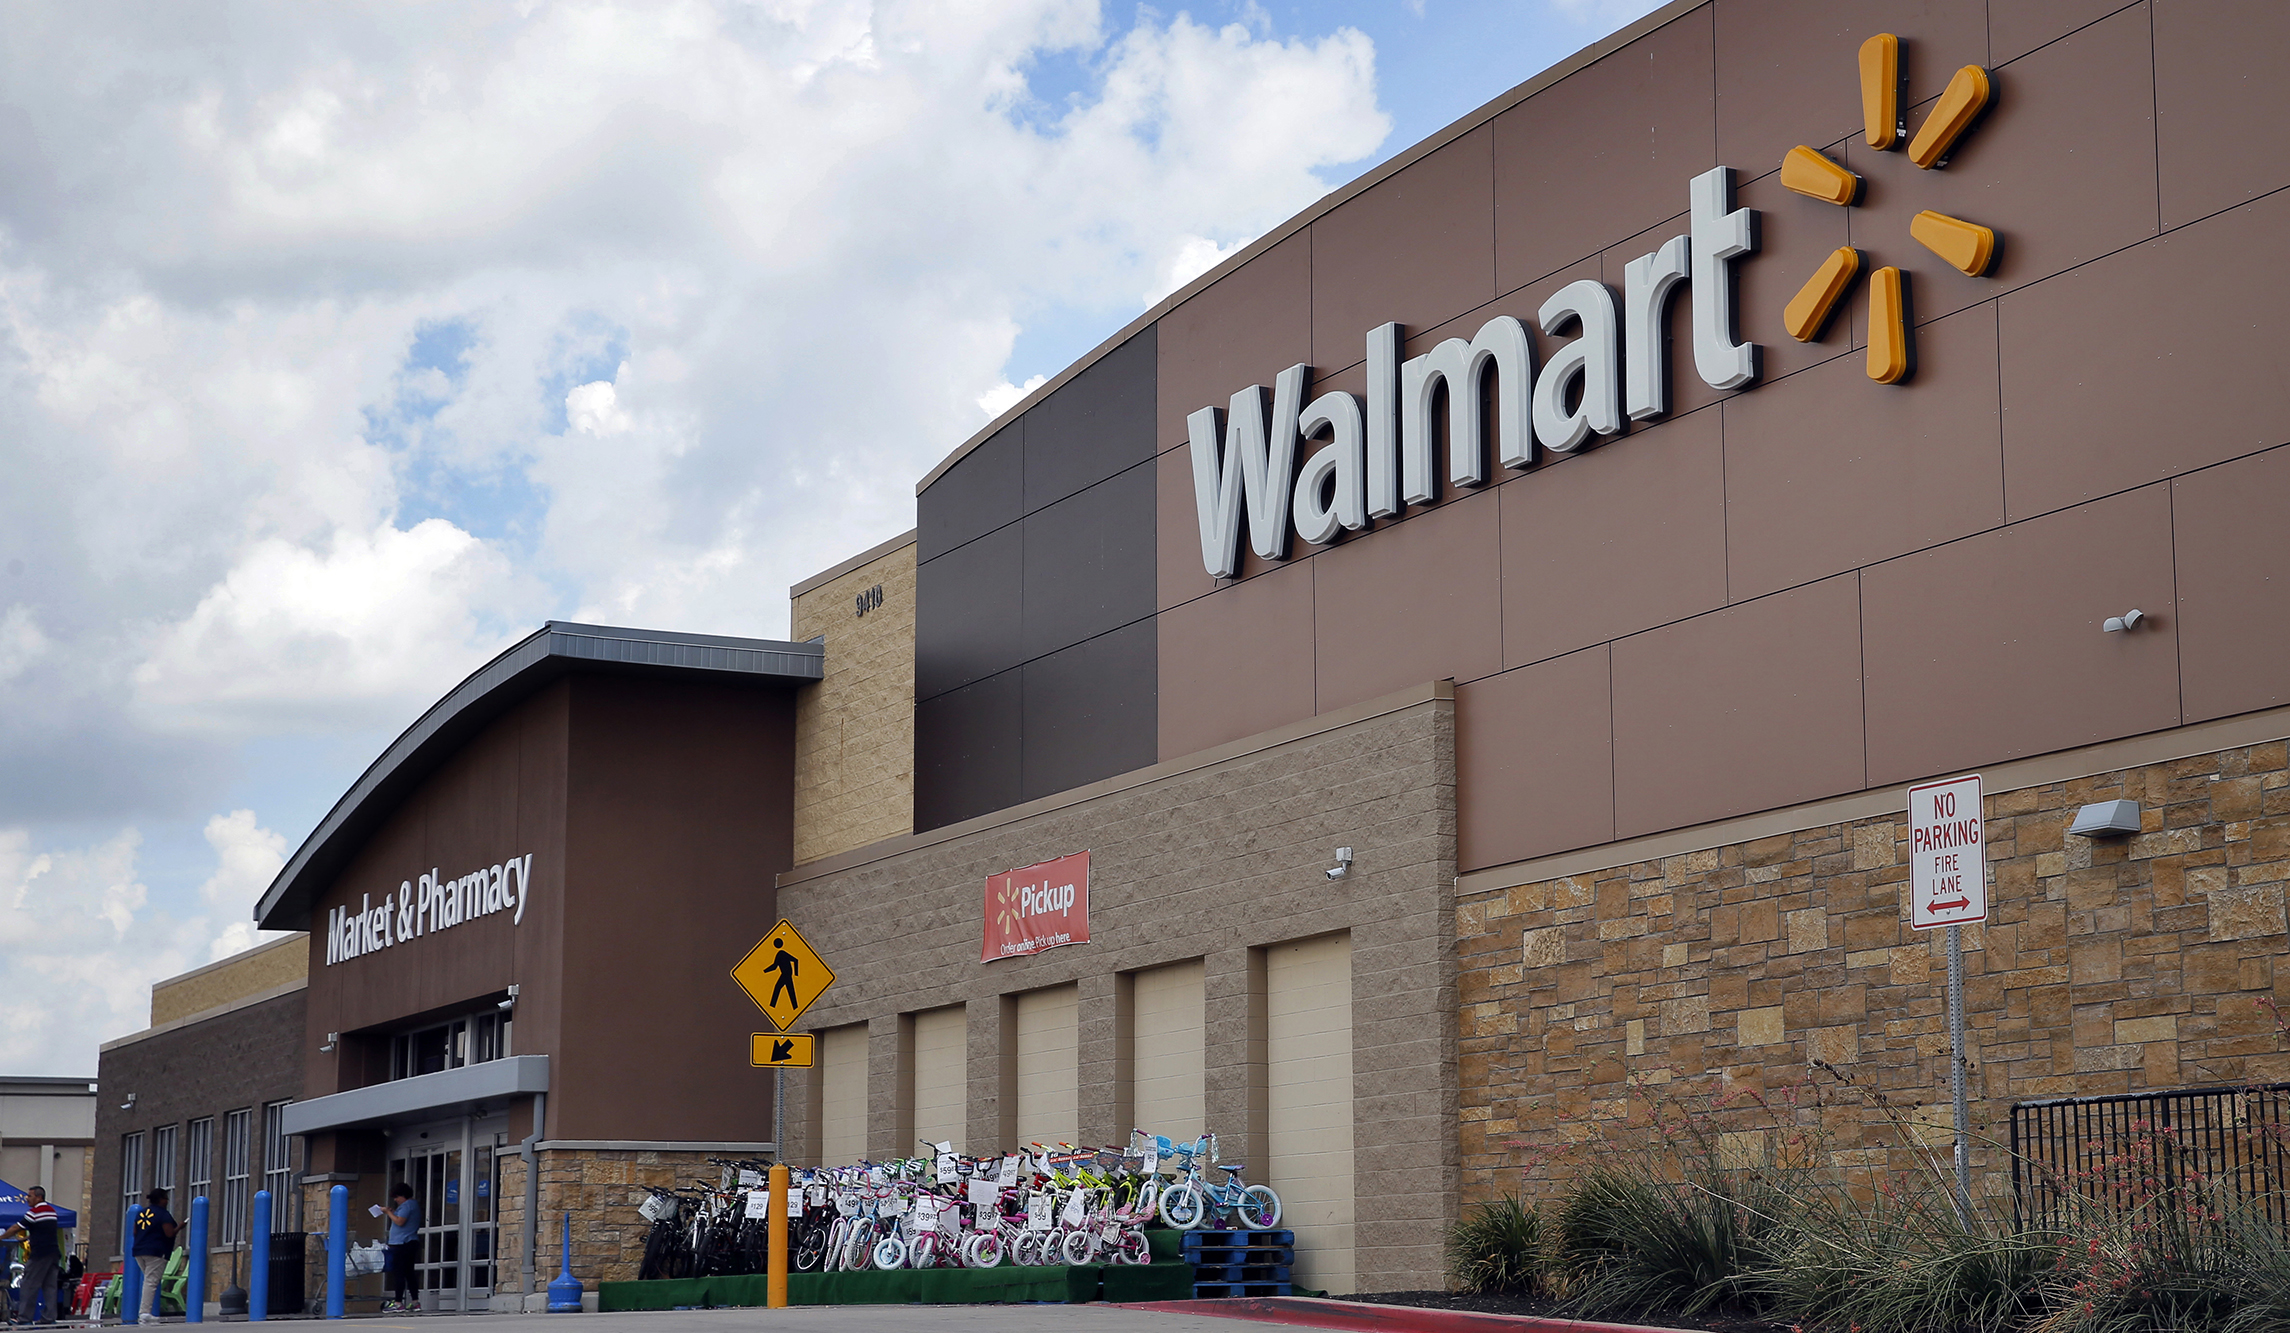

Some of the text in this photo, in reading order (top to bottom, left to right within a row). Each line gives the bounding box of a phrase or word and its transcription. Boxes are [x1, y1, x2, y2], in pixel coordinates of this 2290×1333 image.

[1187, 166, 1762, 580] Walmart
[856, 584, 883, 617] 9410
[1934, 792, 1956, 819] NO
[1914, 818, 1979, 853] PARKING
[1934, 854, 1959, 874] FIRE
[1021, 880, 1075, 918] Pickup
[1932, 875, 1962, 895] LANE
[326, 853, 533, 966] Market & Pharmacy
[1000, 943, 1016, 956] Order
